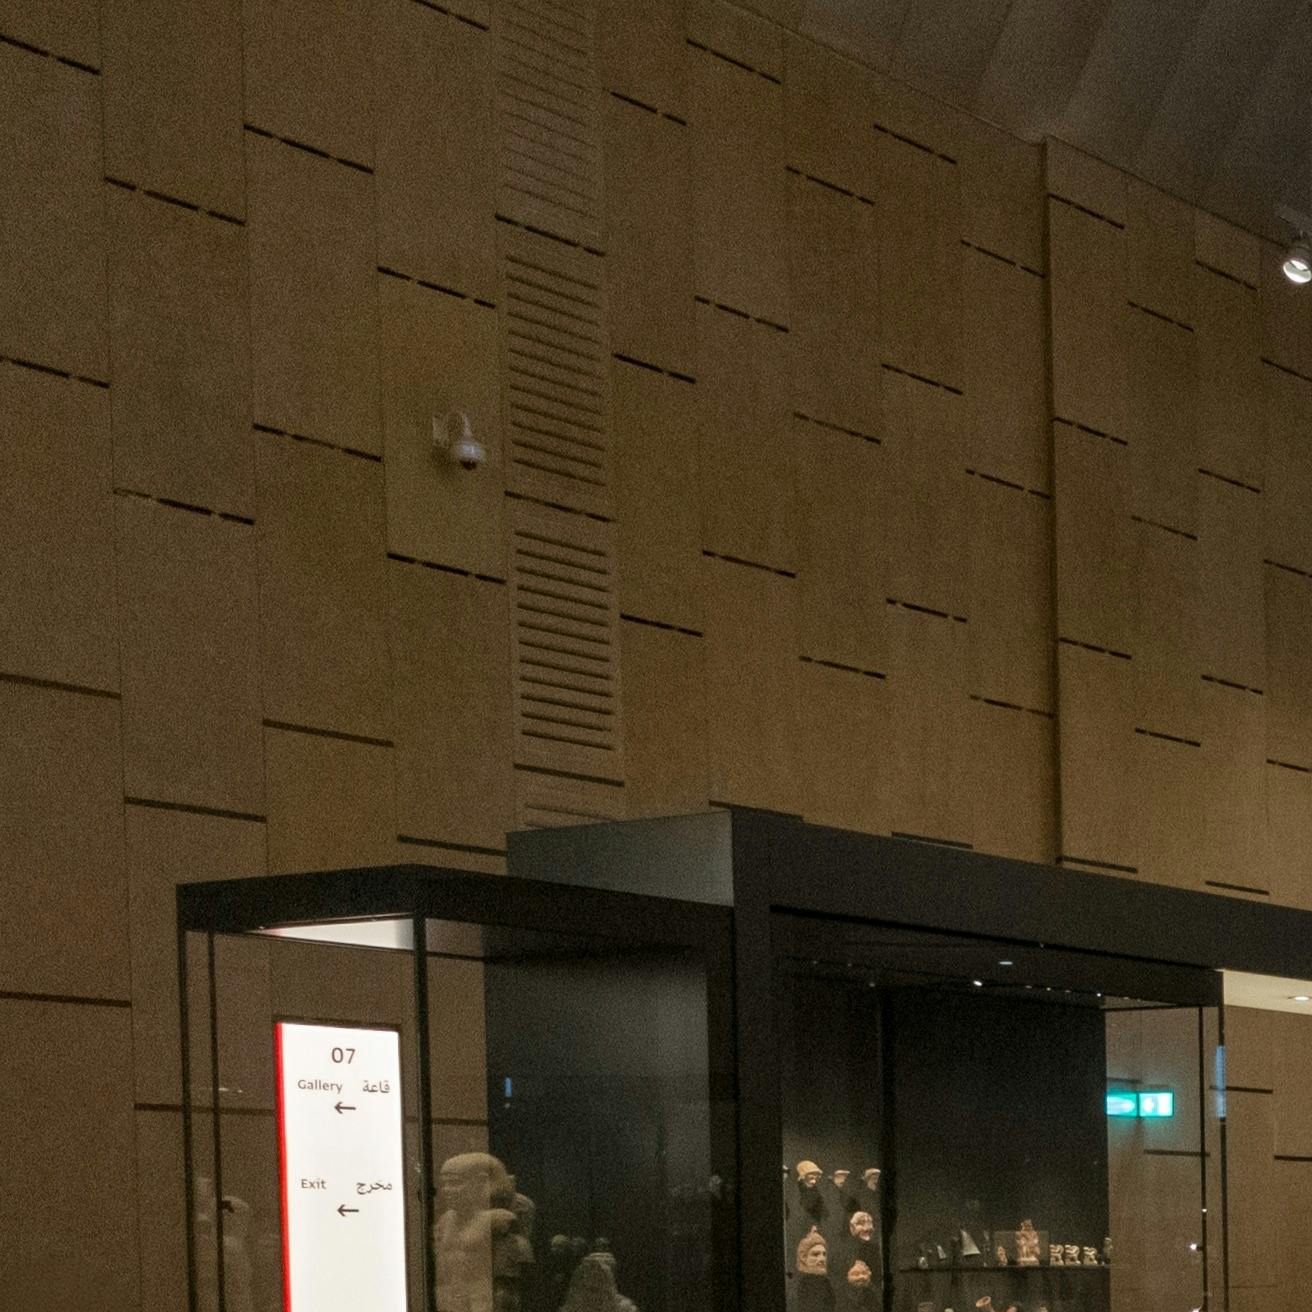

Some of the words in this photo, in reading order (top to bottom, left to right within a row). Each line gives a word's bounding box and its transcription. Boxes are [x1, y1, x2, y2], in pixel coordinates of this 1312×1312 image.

[331, 1047, 356, 1064] 07
[297, 1079, 343, 1094] Gallery
[362, 1079, 390, 1093] قاعة
[301, 1178, 327, 1190] Exit
[356, 1180, 392, 1195] مخرج
